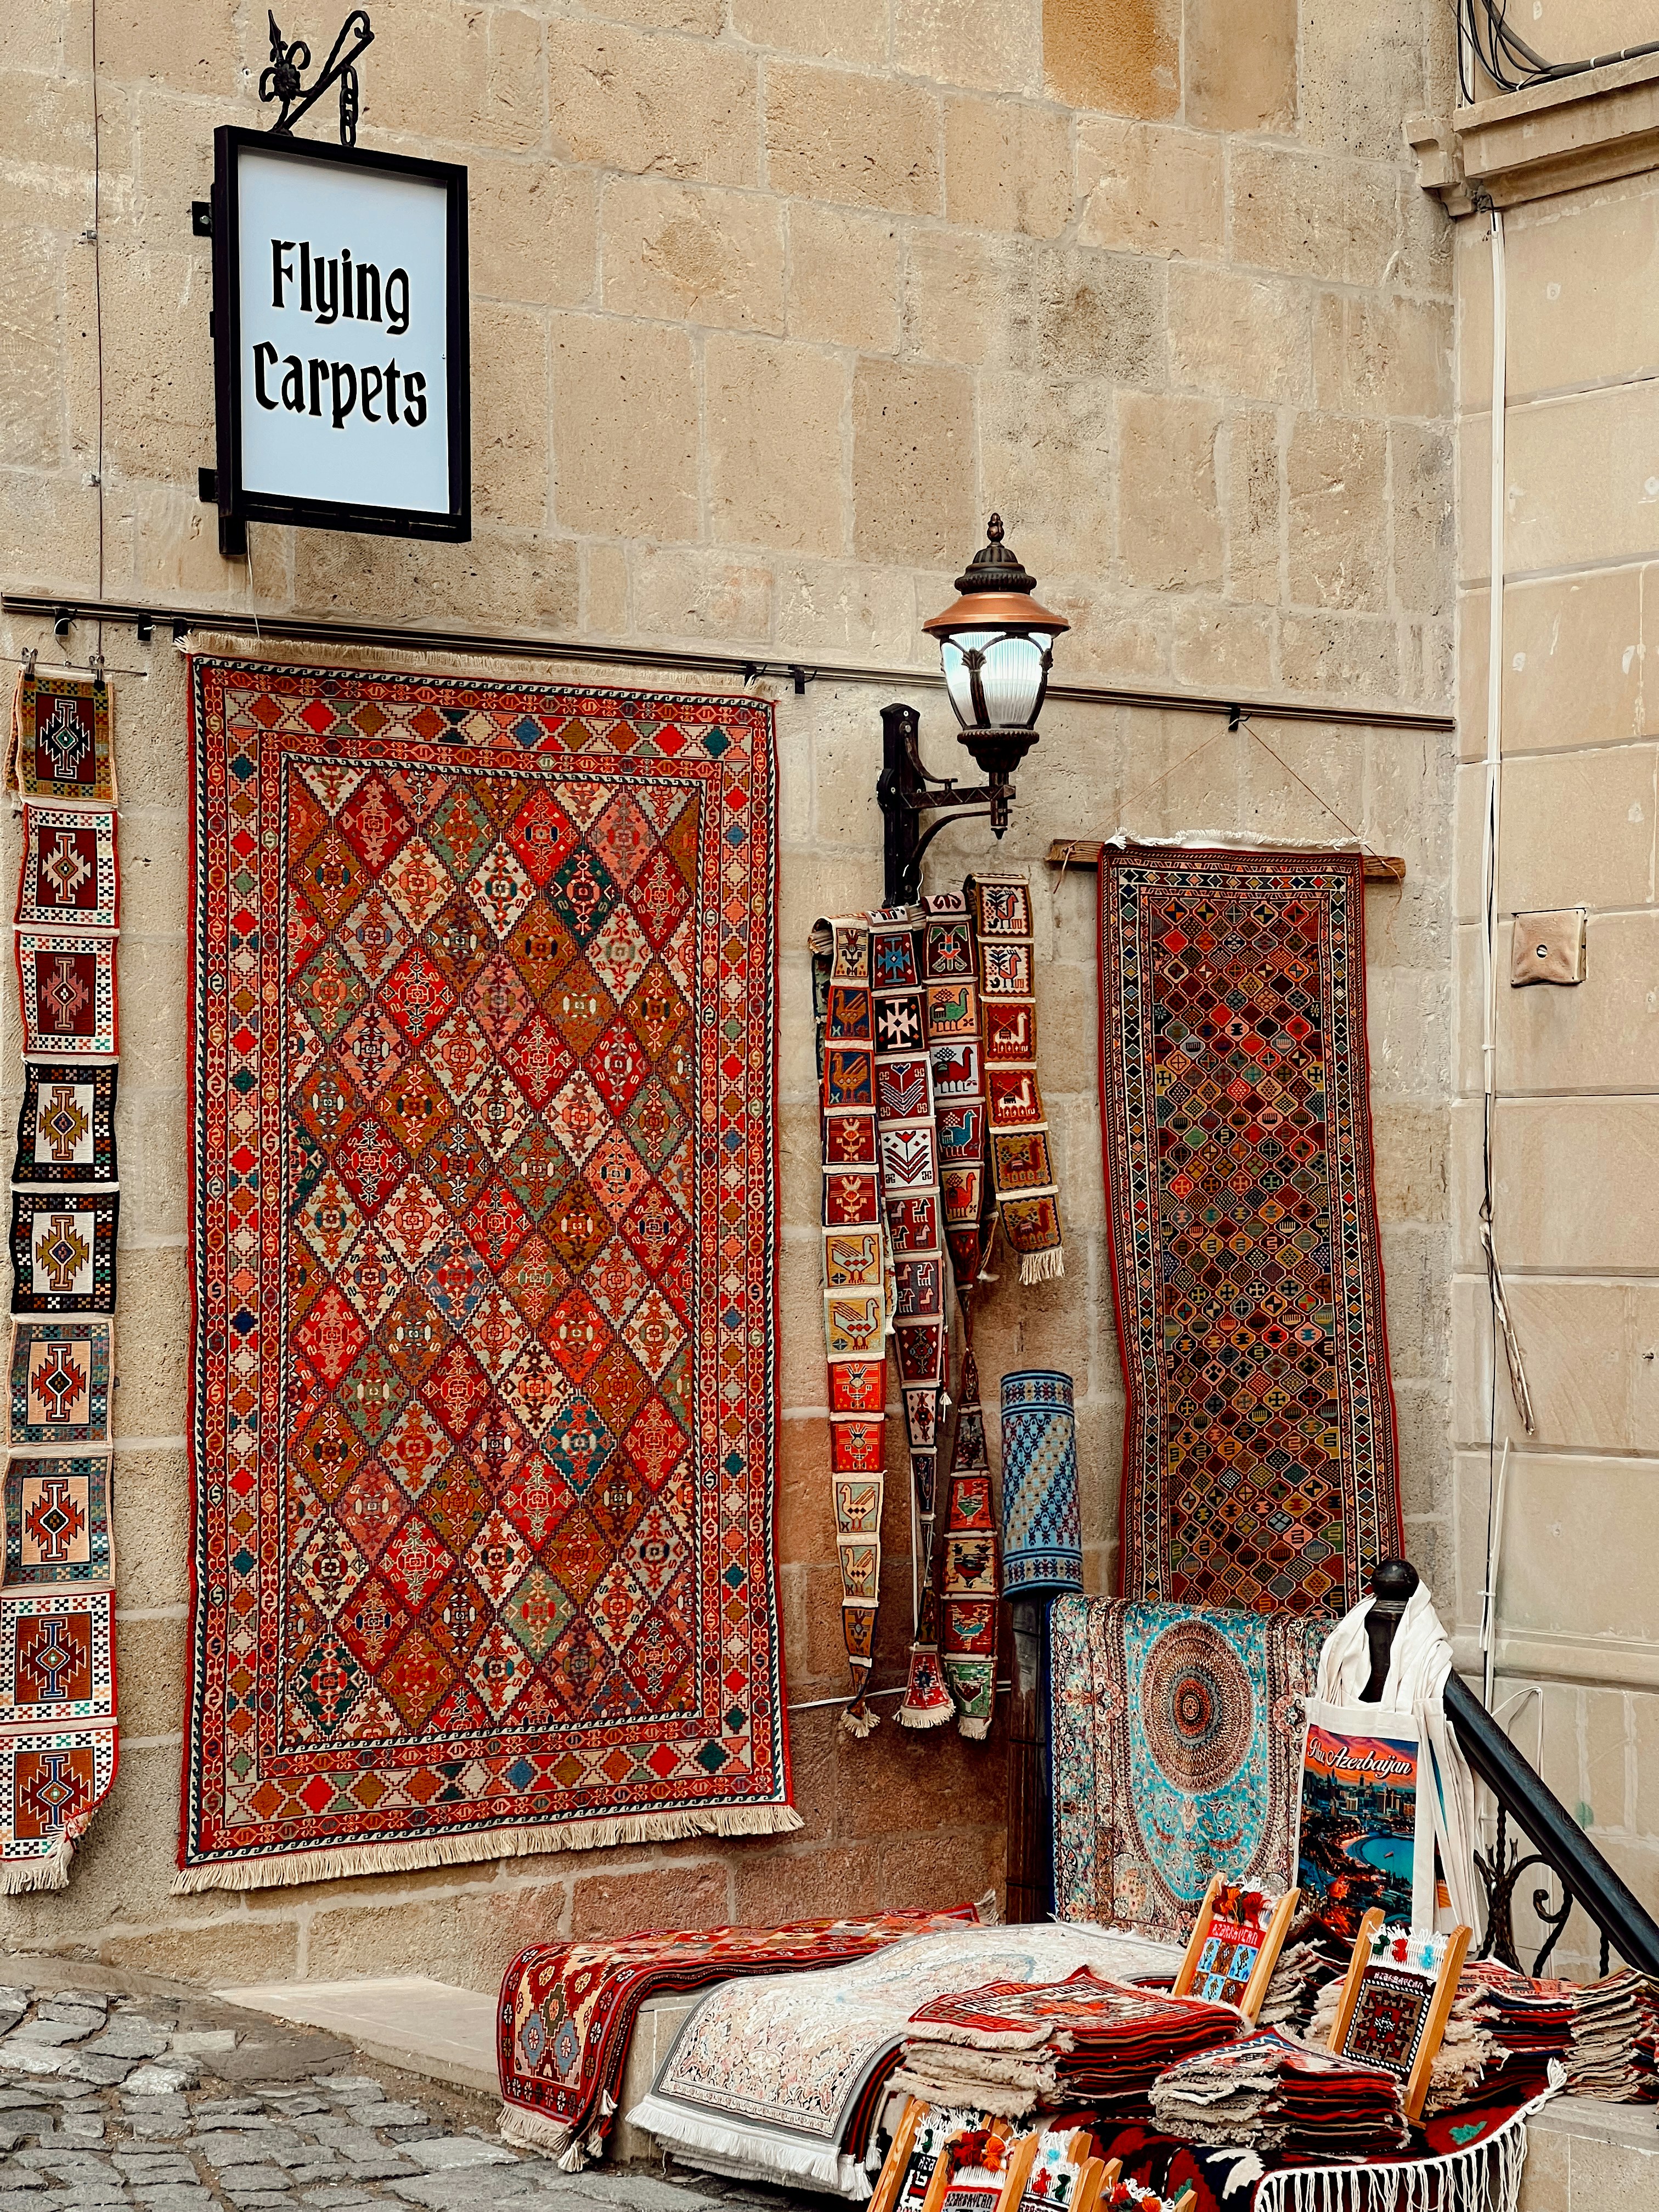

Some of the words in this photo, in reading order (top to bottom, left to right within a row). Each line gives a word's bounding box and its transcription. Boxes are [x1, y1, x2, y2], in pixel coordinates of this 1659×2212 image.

[271, 239, 409, 335] Flying
[253, 341, 427, 429] Carpets
[1327, 1746, 1412, 1779] Azerbaijan
